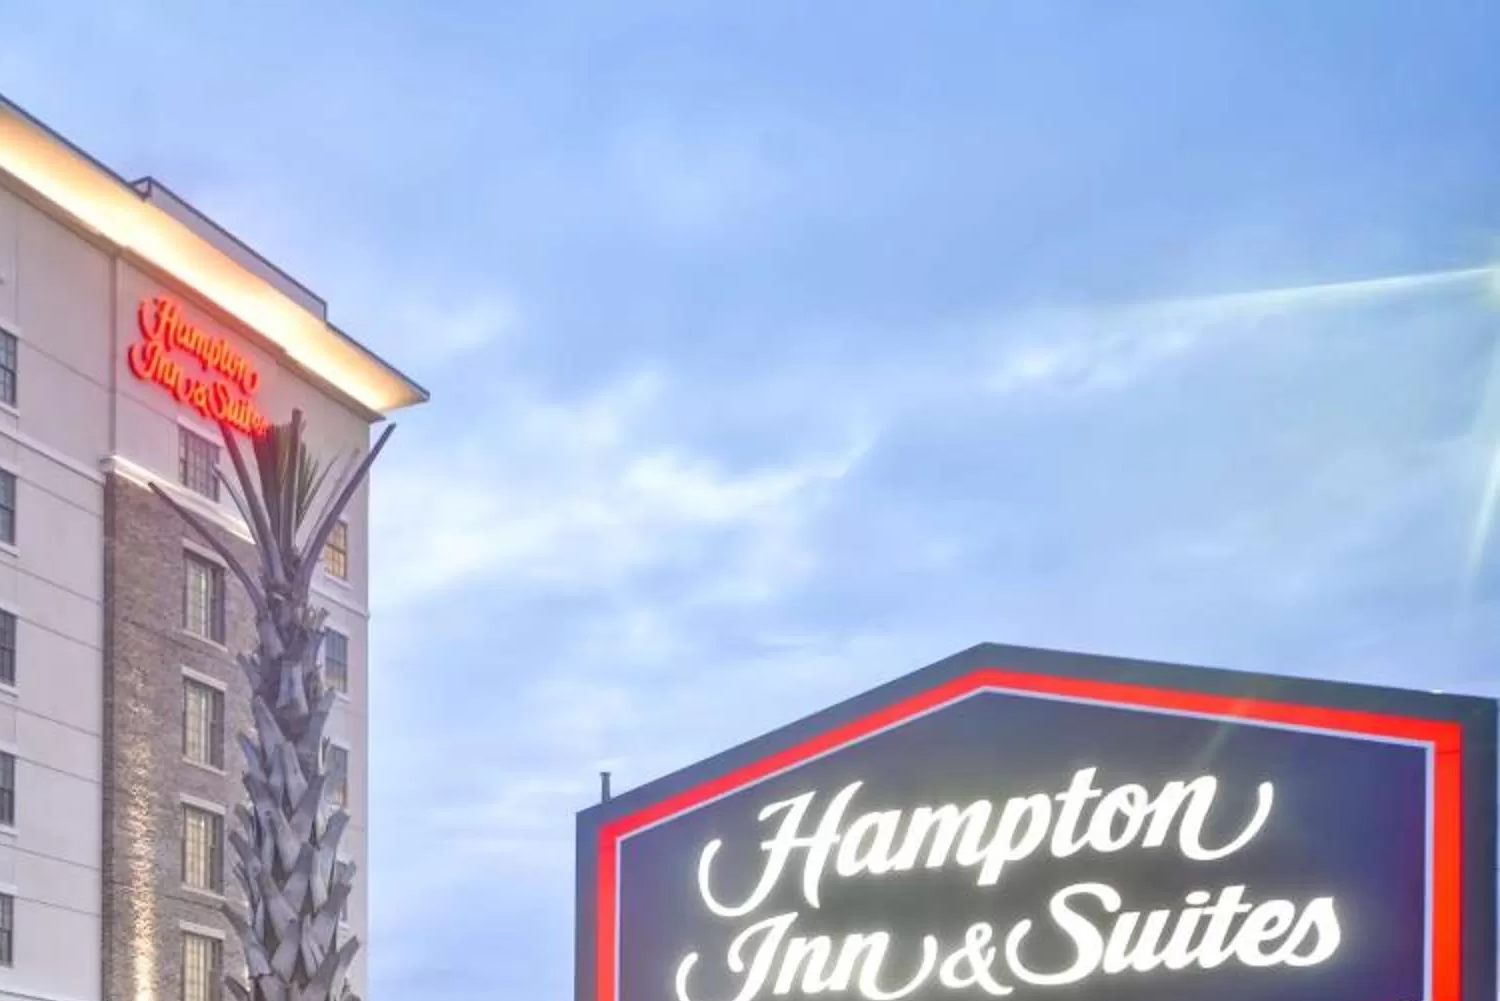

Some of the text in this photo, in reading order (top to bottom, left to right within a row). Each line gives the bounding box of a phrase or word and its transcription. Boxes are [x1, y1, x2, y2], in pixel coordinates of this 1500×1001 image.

[128, 342, 192, 402] Inn
[138, 294, 260, 396] Hampton
[698, 766, 1274, 917] Hampton
[940, 921, 1013, 995] &
[1005, 883, 1342, 986] Suites
